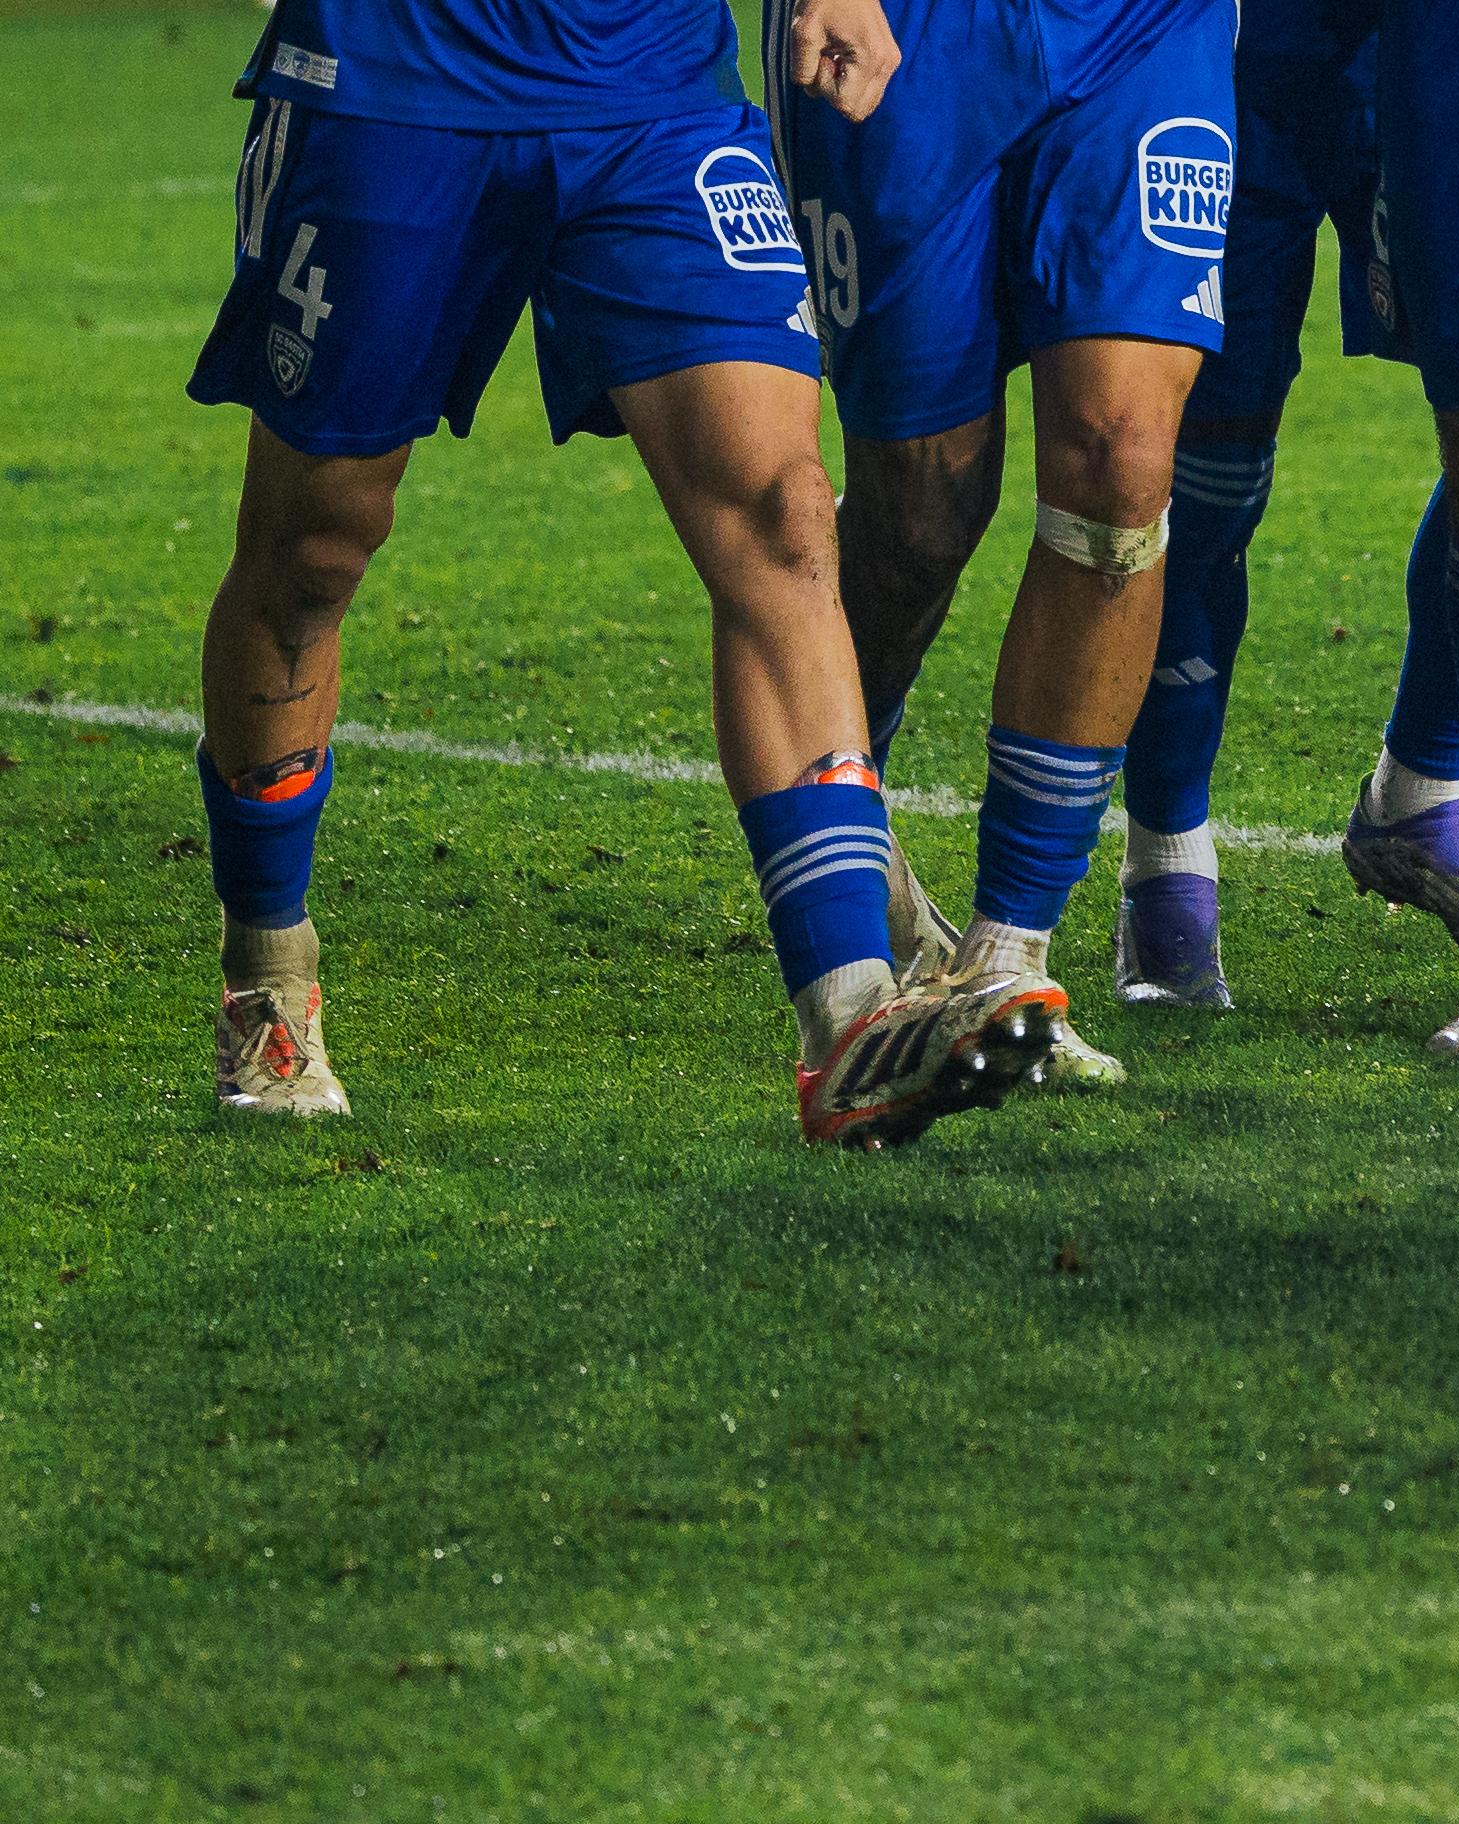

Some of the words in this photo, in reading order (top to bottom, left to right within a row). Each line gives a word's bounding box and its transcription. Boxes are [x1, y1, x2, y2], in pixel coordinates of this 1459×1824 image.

[800, 197, 860, 329] 19
[1147, 186, 1229, 231] KING
[276, 221, 334, 343] 4
